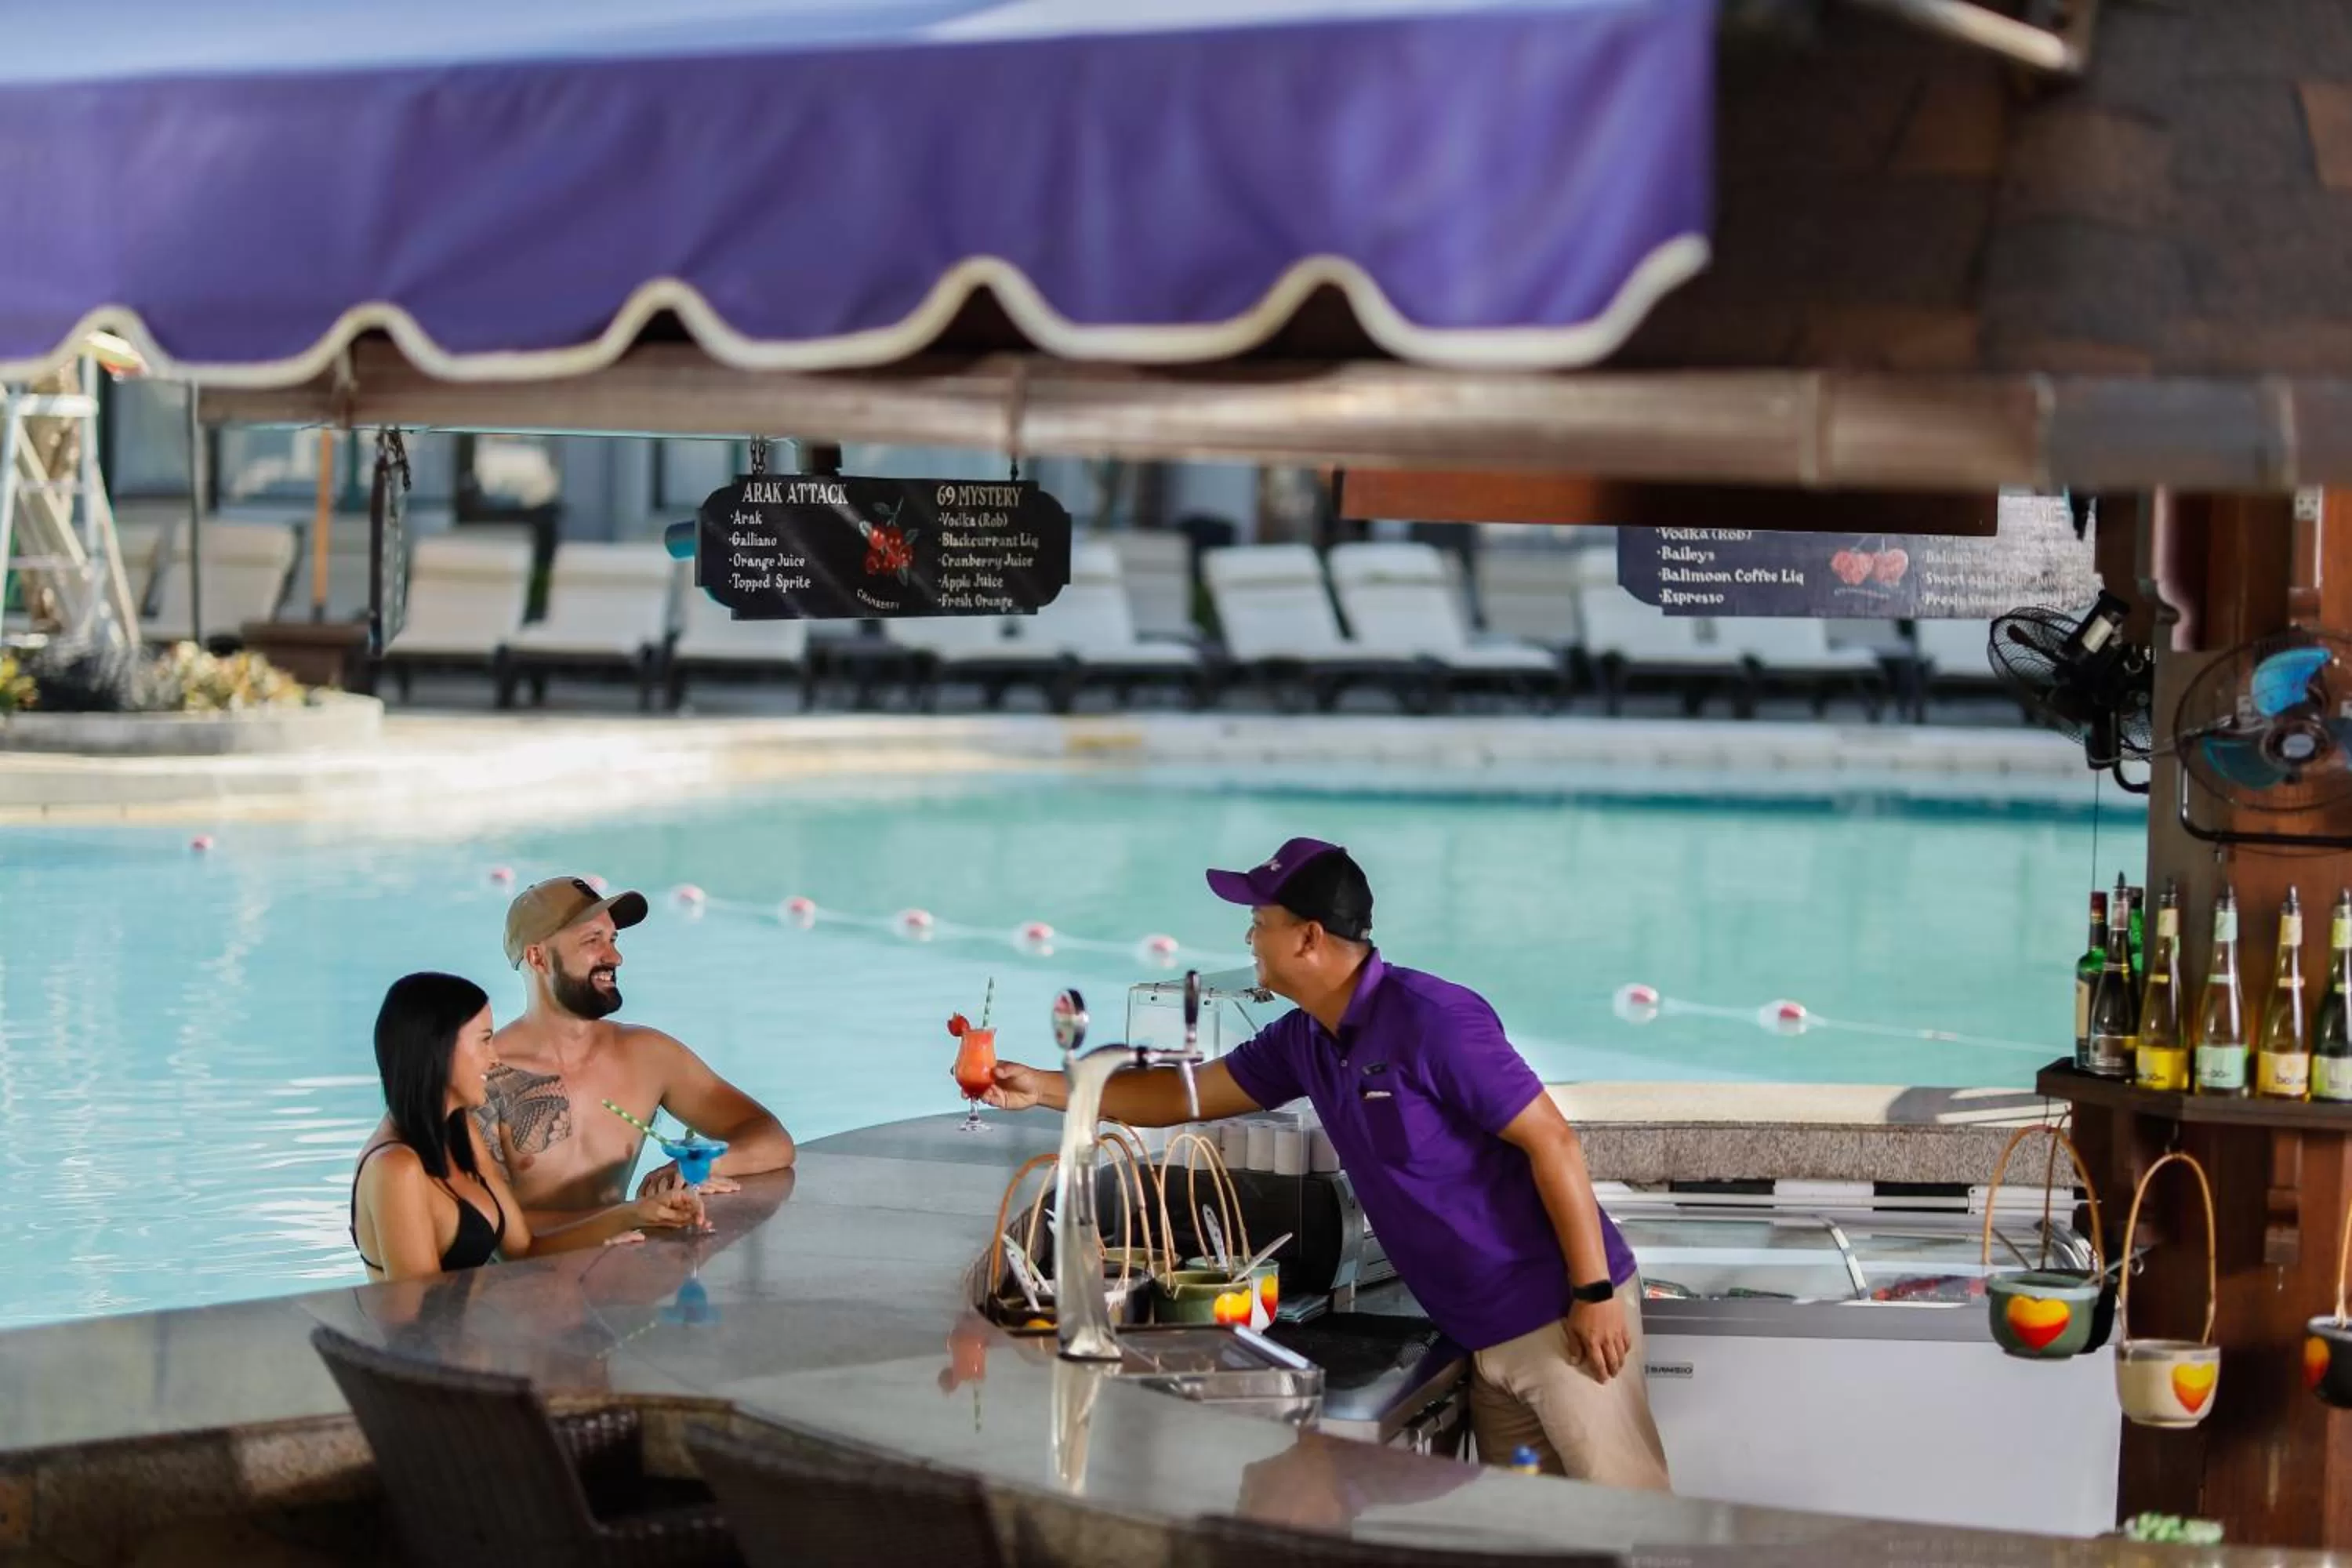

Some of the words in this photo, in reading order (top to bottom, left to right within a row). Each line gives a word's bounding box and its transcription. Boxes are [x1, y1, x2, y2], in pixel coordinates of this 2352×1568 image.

[742, 482, 782, 503] ARAK
[786, 482, 849, 504] ATTACK
[937, 485, 956, 506] 69
[958, 486, 1023, 507] MYSTERY
[733, 509, 762, 524] Arak
[941, 512, 976, 527] Vodka
[978, 512, 1008, 527] (Rob)
[731, 531, 777, 546] Galliano
[942, 532, 1018, 546] Blackcurrant
[733, 553, 775, 571] Orange
[778, 553, 805, 567] Juice
[942, 553, 1003, 571] Cranberry
[1004, 553, 1034, 567] Juice
[1661, 545, 1715, 564] Baileys
[732, 573, 771, 592] Topped
[775, 573, 811, 593] Sprite
[941, 574, 971, 592] Apple
[974, 573, 1004, 588] Juice
[1661, 568, 1732, 583] Balimoon
[1734, 568, 1778, 583] Coffee
[942, 593, 973, 607] Fresh
[975, 593, 1013, 613] Orange
[1662, 589, 1725, 606] Espresso
